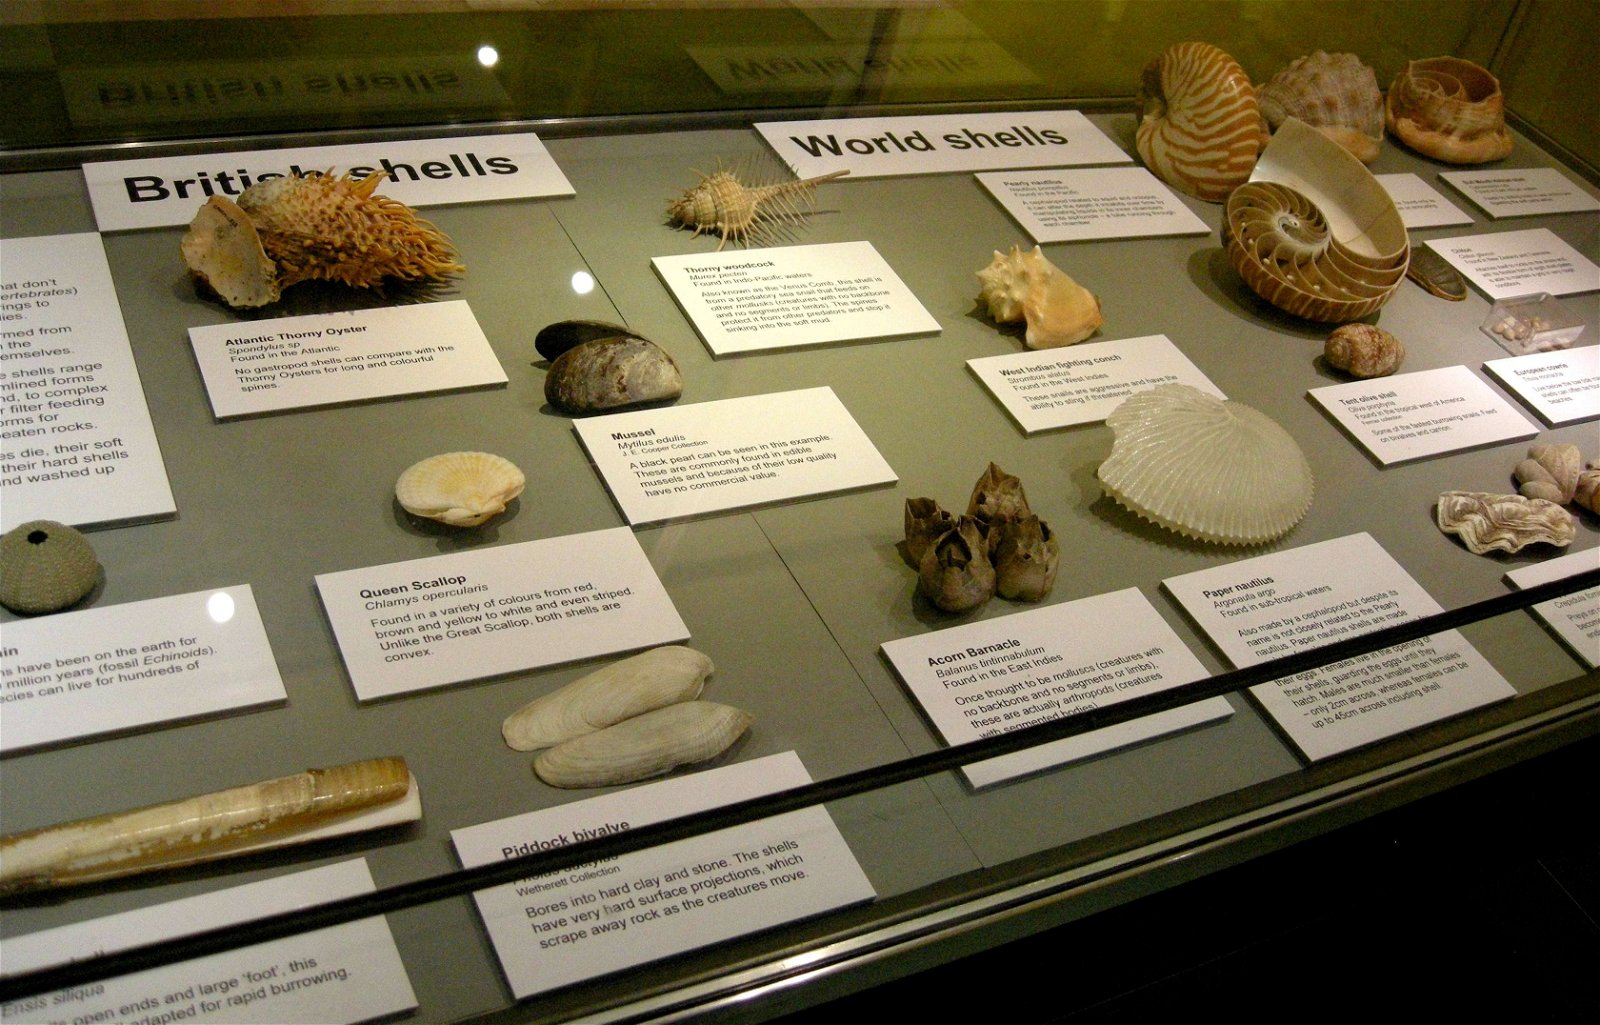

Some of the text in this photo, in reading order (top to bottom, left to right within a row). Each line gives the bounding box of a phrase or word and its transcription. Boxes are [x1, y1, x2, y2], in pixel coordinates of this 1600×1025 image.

[789, 125, 1069, 158] World shells
[348, 152, 519, 183] shells
[683, 260, 775, 273] Thorny woodcock
[21, 278, 57, 288] don't
[692, 279, 722, 288] Found
[733, 273, 784, 284] Indo-Pacific
[784, 271, 813, 280] waters
[38, 325, 72, 335] from
[225, 326, 366, 346] Atlantic Thorny Oyster
[228, 341, 301, 355] Spondylus sp
[229, 352, 266, 362] Found
[300, 345, 340, 355] Atlantic
[11, 362, 102, 378] shells range
[237, 374, 276, 383] Thorny
[278, 369, 322, 379] Oysters
[340, 363, 365, 371] long
[366, 360, 387, 368] and
[388, 354, 434, 366] colourful
[998, 354, 1122, 376] West Indian fighting conch
[24, 384, 108, 400] to complex
[1012, 382, 1040, 391] Found
[1061, 375, 1085, 384] West
[9, 396, 105, 413] filter feeding
[1338, 397, 1360, 405] Tent
[1377, 391, 1398, 399] shell
[610, 427, 656, 440] Mussel
[617, 434, 686, 450] Mytilus edulis
[633, 468, 668, 478] These
[669, 465, 687, 473] are
[688, 457, 740, 470] commonly
[740, 451, 770, 462] found
[782, 446, 812, 456] edible
[638, 457, 668, 468] black
[668, 453, 696, 465] pearl
[696, 451, 717, 459] can
[732, 445, 758, 454] seen
[644, 488, 672, 497] have
[673, 485, 688, 493] no
[689, 474, 749, 490] commercial
[359, 575, 466, 599] Queen Scallop
[364, 584, 489, 611] Chlamys opercularis
[1202, 576, 1275, 599] Paper nautilus
[1213, 588, 1276, 609] Argonauta argo
[370, 581, 597, 628] Found in a variety of colours from red,
[1219, 585, 1332, 618] Found in sub-tropical waters
[16, 636, 197, 674] have been on the earth for
[384, 648, 434, 663] convex.
[927, 638, 1021, 667] Acorn Barnacle
[935, 646, 1045, 678] Balanus tintinnabulum
[5, 645, 218, 689] million years (fossil Echinoids).
[941, 654, 1064, 689] Found in the East Indies
[954, 647, 1164, 706] Once thought to be molluscs (creatures with
[1311, 719, 1325, 729] up
[1322, 716, 1335, 724] to
[1334, 708, 1359, 720] 45cm
[1358, 699, 1387, 714] across
[1386, 688, 1424, 704] including
[501, 821, 630, 859] Piddock bivalve
[524, 839, 799, 918] Bores into hard clay and stone. The shells
[539, 870, 810, 949] scrape away rock as the creatures move.
[118, 997, 160, 1016] ends
[164, 986, 195, 1005] and
[197, 978, 239, 996] large
[288, 958, 318, 973] this
[199, 967, 351, 1014] for rapid burrowing.
